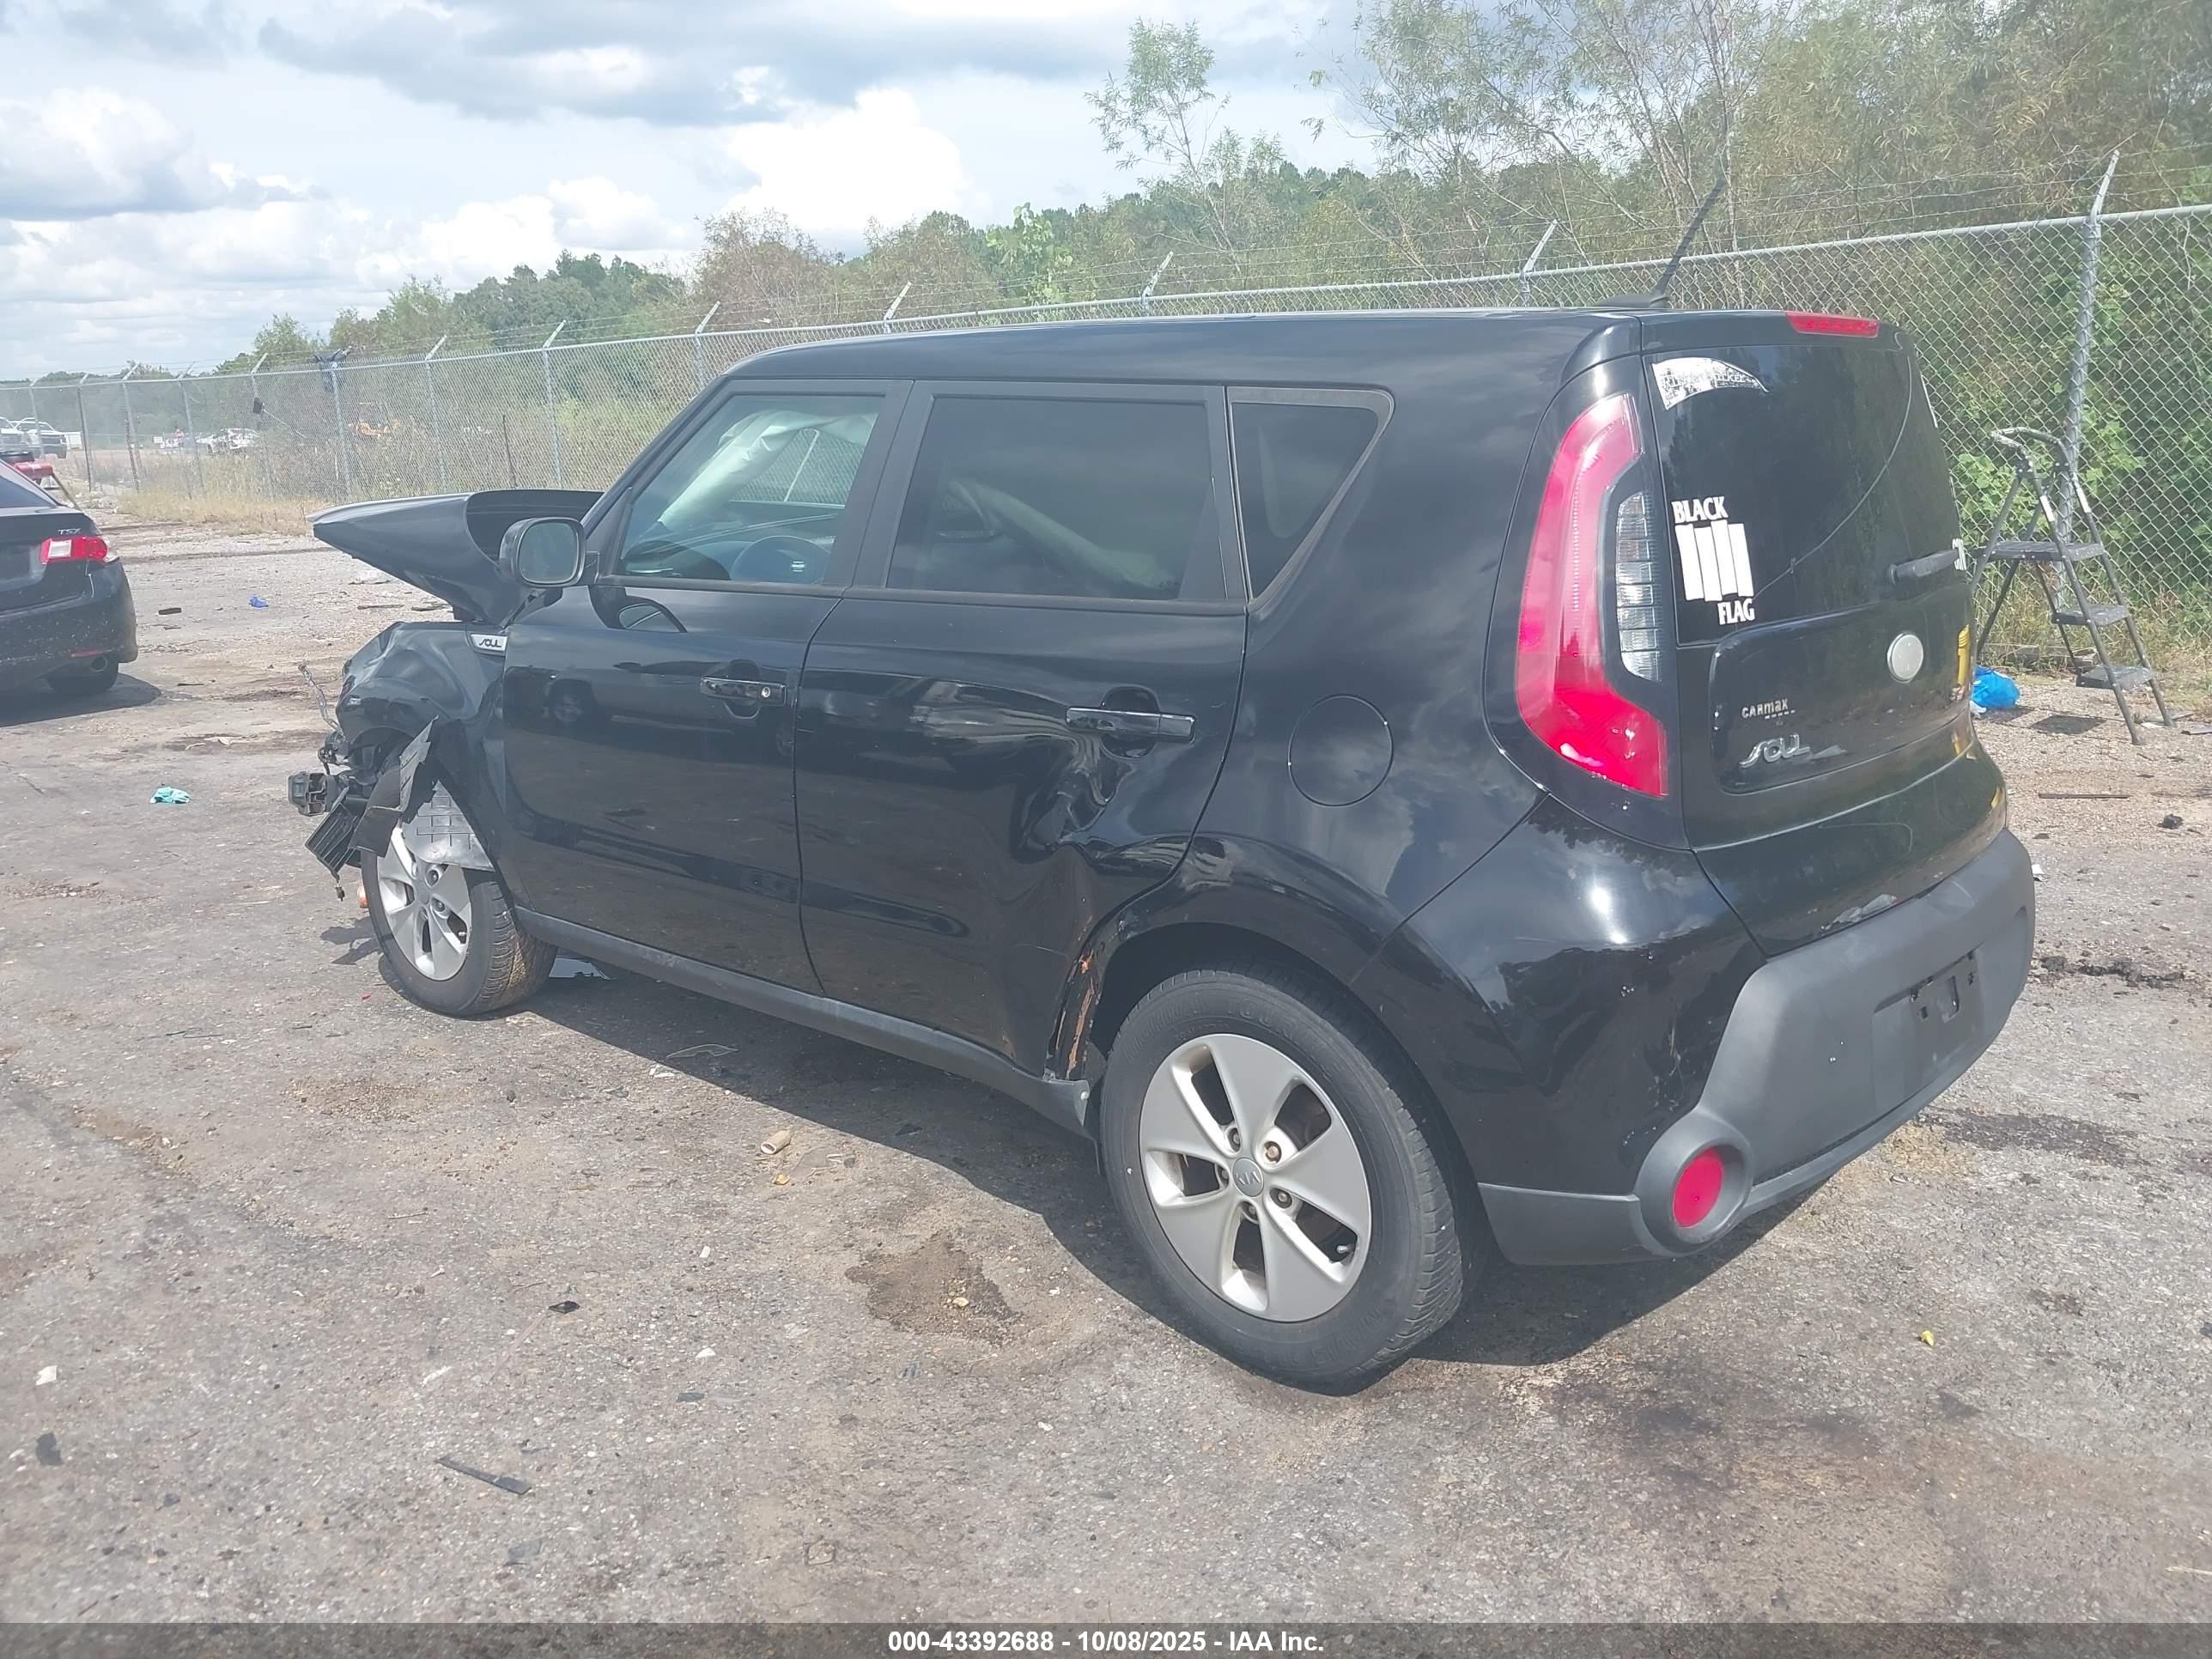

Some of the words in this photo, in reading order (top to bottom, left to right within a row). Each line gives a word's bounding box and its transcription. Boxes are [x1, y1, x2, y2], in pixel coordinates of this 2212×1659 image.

[1671, 495, 1729, 524] BLACK
[1717, 598, 1755, 625] FLAG
[1738, 733, 1810, 769] SOUL
